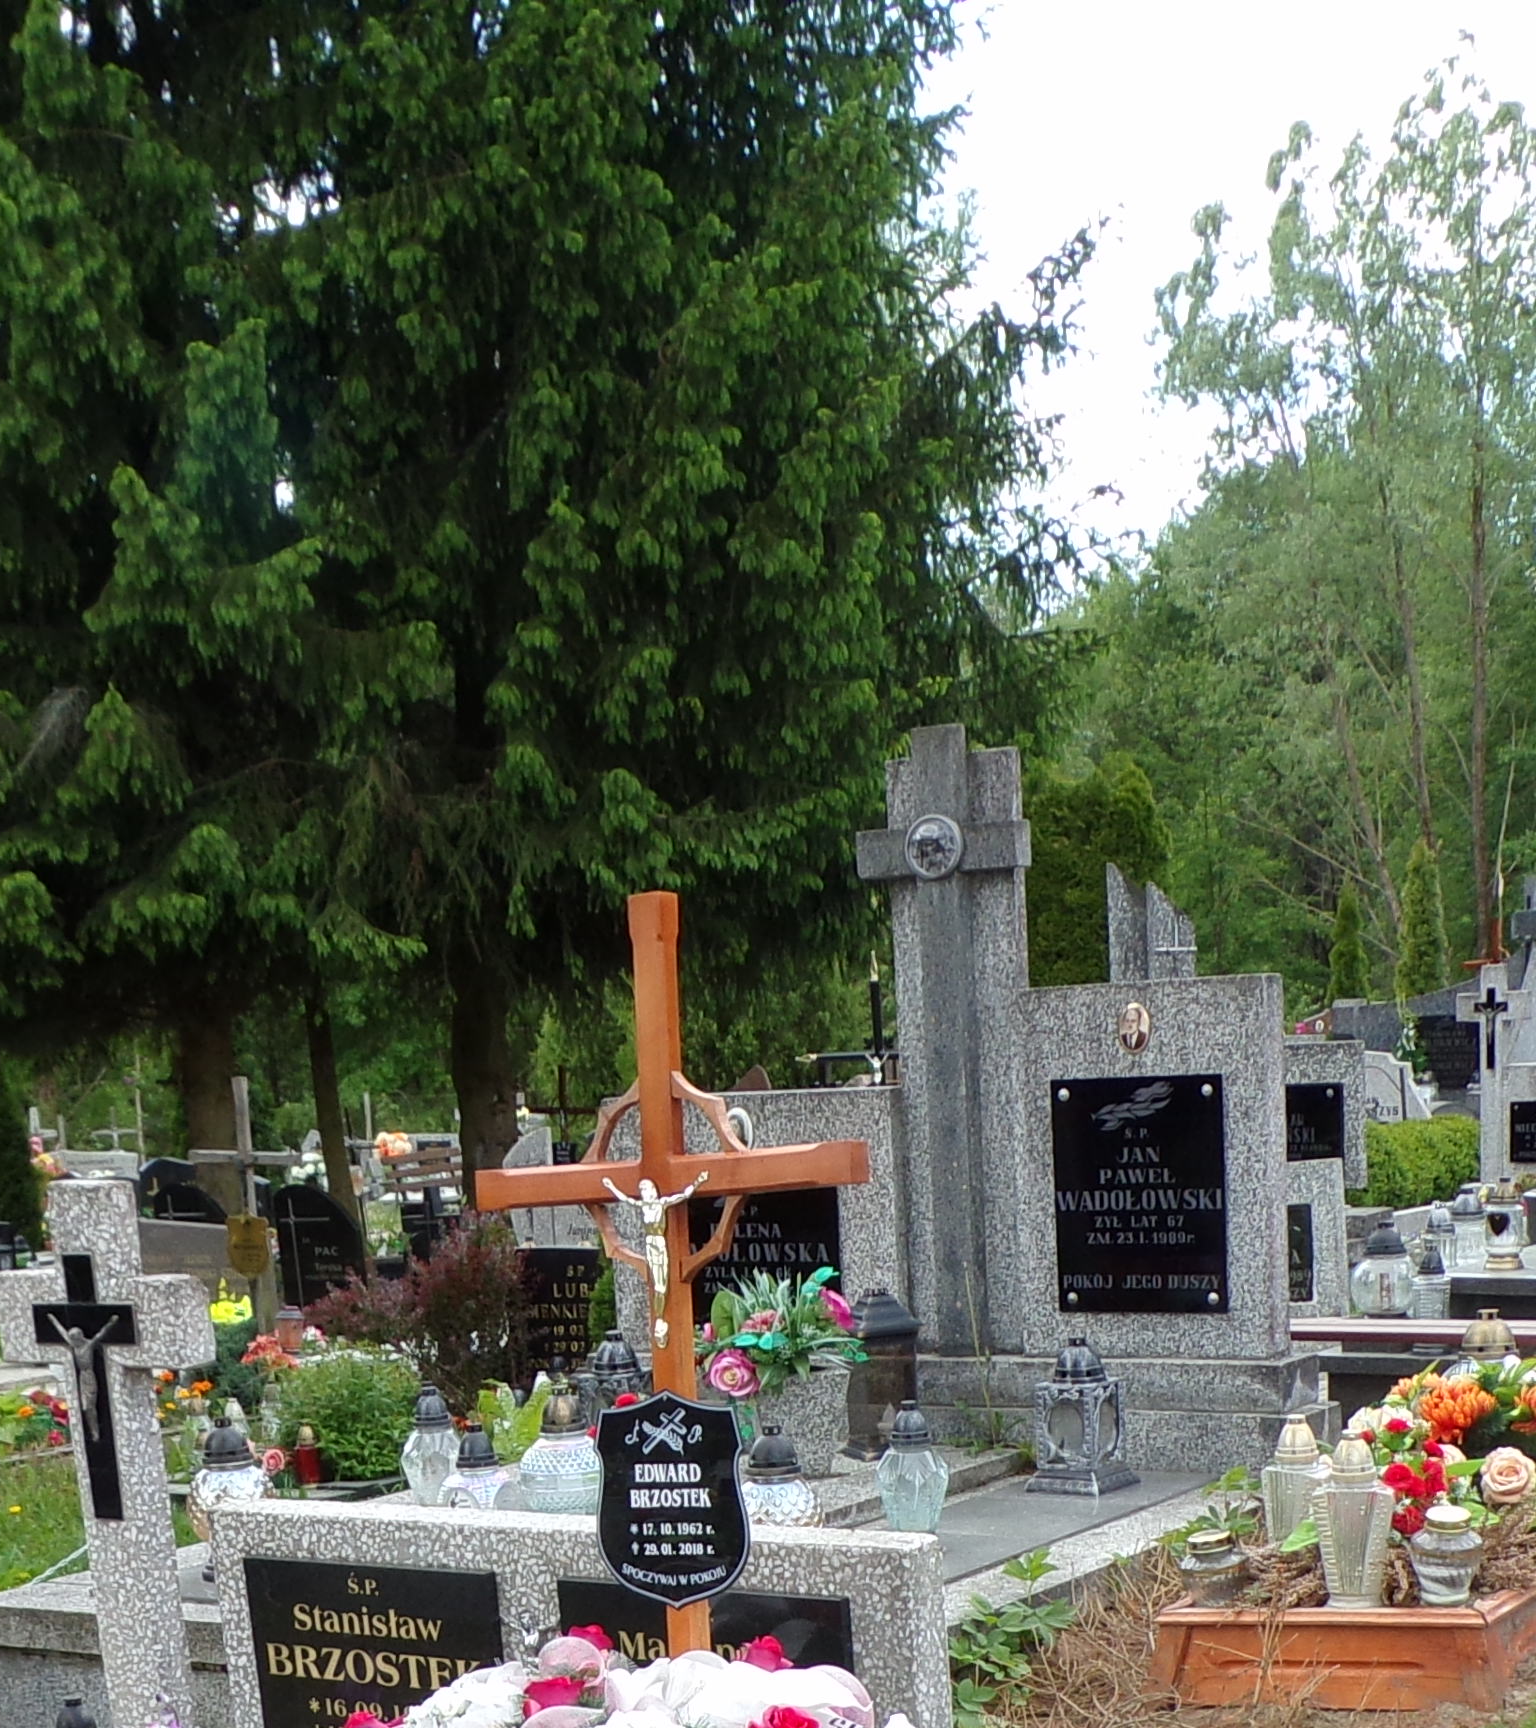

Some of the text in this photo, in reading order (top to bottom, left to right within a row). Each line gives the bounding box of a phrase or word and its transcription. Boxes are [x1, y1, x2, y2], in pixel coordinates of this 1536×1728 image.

[1116, 1146, 1161, 1164] JAN
[1099, 1168, 1176, 1185] PAWEŁ
[1121, 1273, 1163, 1290] JEGO
[634, 1463, 702, 1483] EDWARD
[630, 1488, 712, 1509] BRZOSTEK
[292, 1603, 443, 1642] Stanisław
